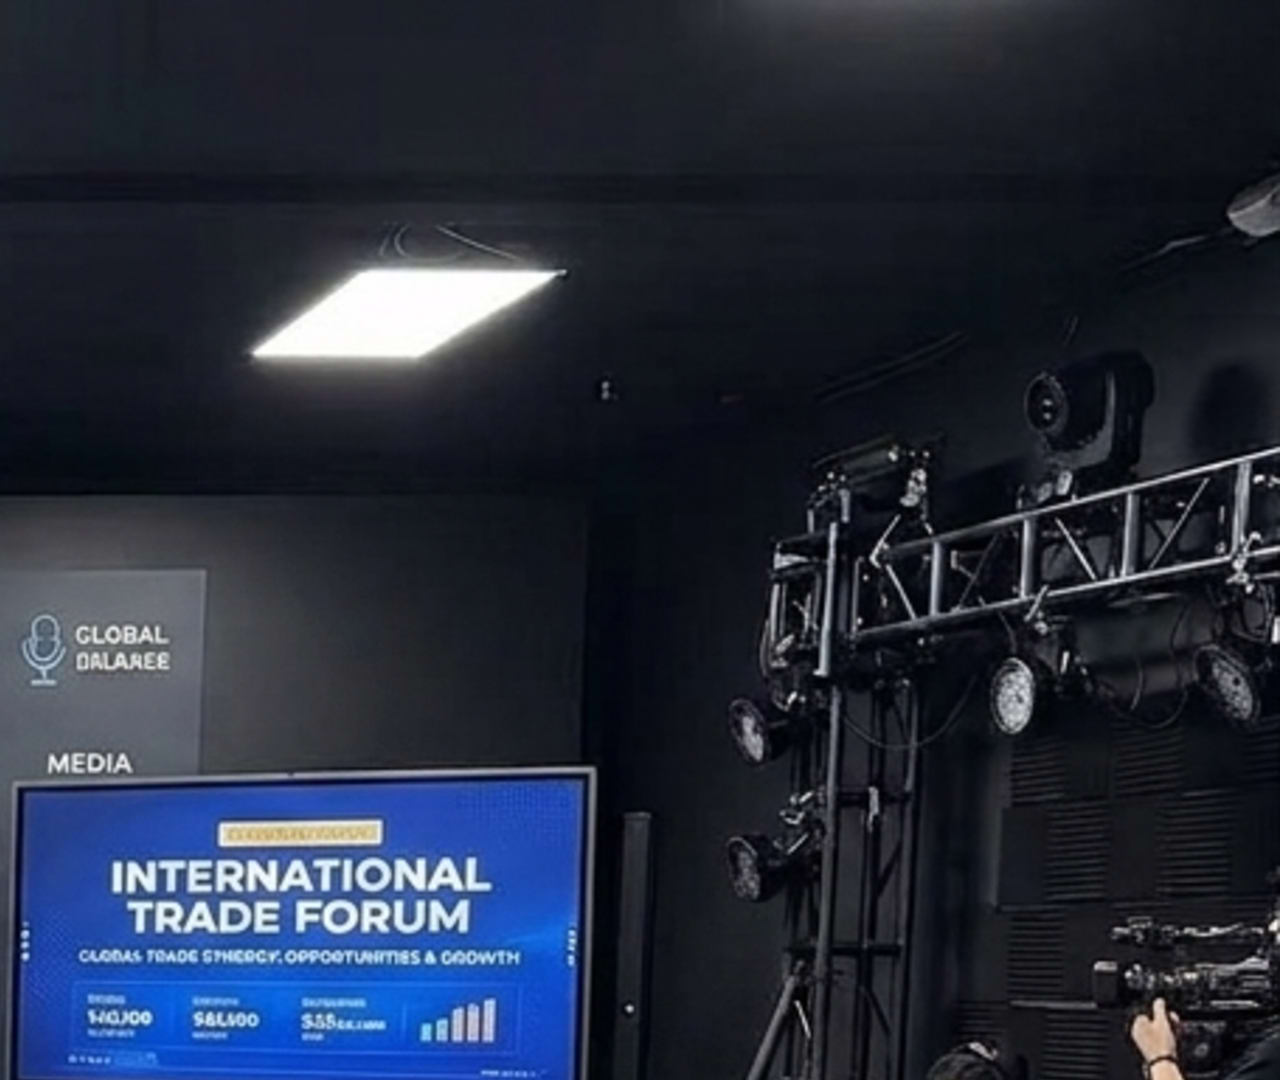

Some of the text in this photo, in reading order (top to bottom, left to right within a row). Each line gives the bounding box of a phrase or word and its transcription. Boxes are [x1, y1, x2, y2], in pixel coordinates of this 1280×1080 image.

[75, 625, 169, 645] GLOBAL
[47, 752, 132, 774] MEDIA
[112, 857, 491, 894] INTERNATIONAL
[127, 899, 469, 934] TRADE FORUM
